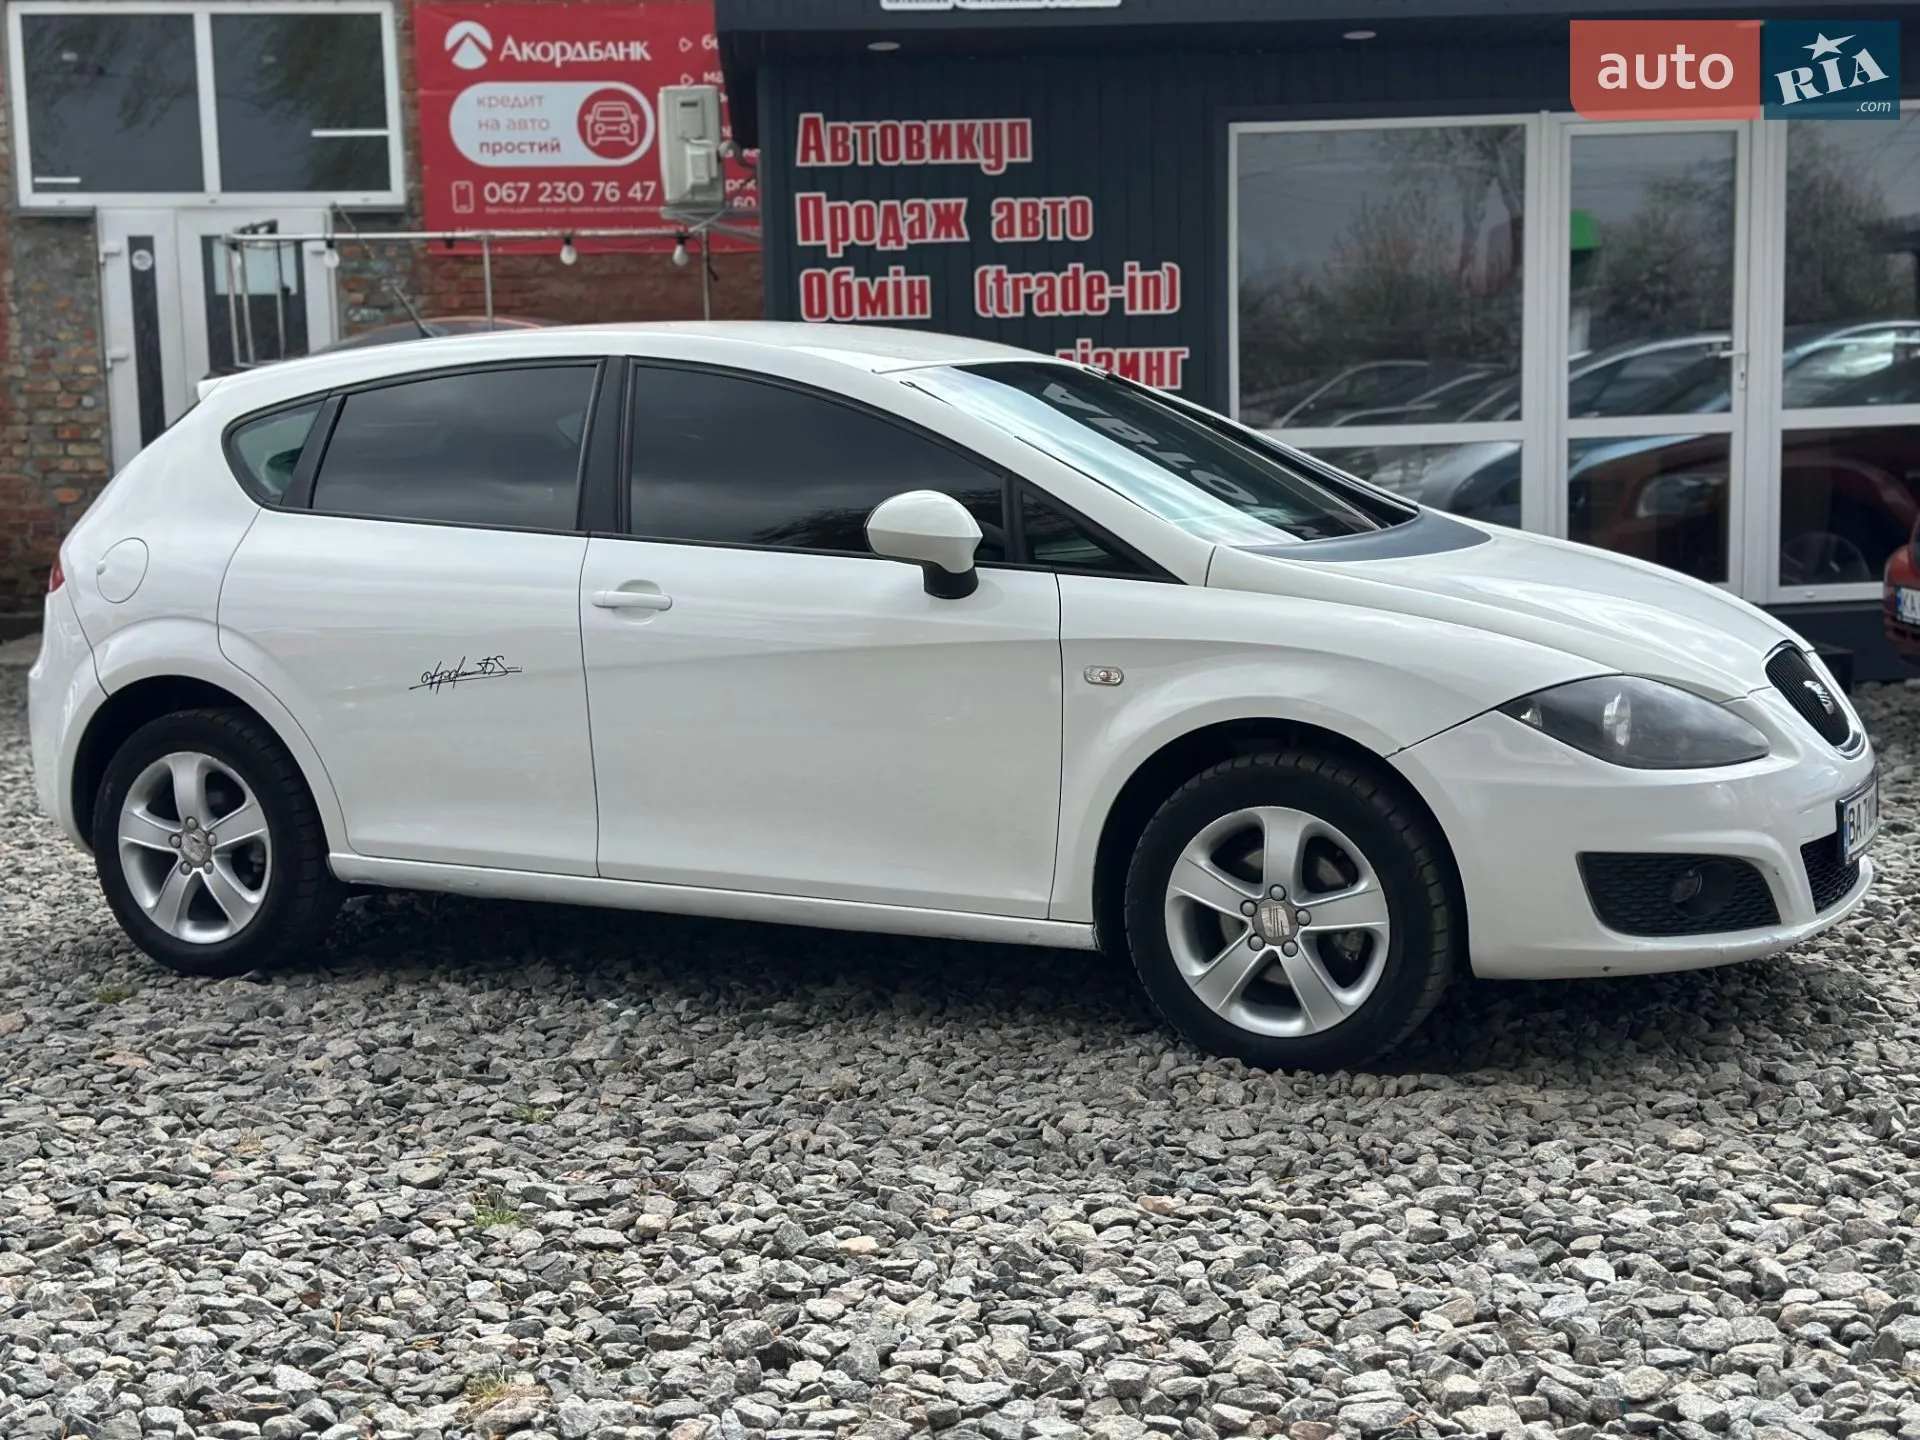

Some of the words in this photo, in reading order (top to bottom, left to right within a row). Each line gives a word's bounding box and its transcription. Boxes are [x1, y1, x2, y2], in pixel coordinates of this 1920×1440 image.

[476, 94, 546, 110] кредит
[478, 118, 501, 131] на
[506, 117, 550, 132] авто
[480, 137, 561, 157] простий
[796, 113, 1032, 175] Автовикуп
[483, 181, 531, 203] 067
[537, 181, 584, 203] 230
[592, 181, 621, 203] 76
[627, 181, 657, 202] 47
[796, 192, 969, 257] Продаж
[991, 196, 1093, 242] авто
[799, 266, 932, 322] Обмін
[975, 262, 1180, 318] (trade-in)
